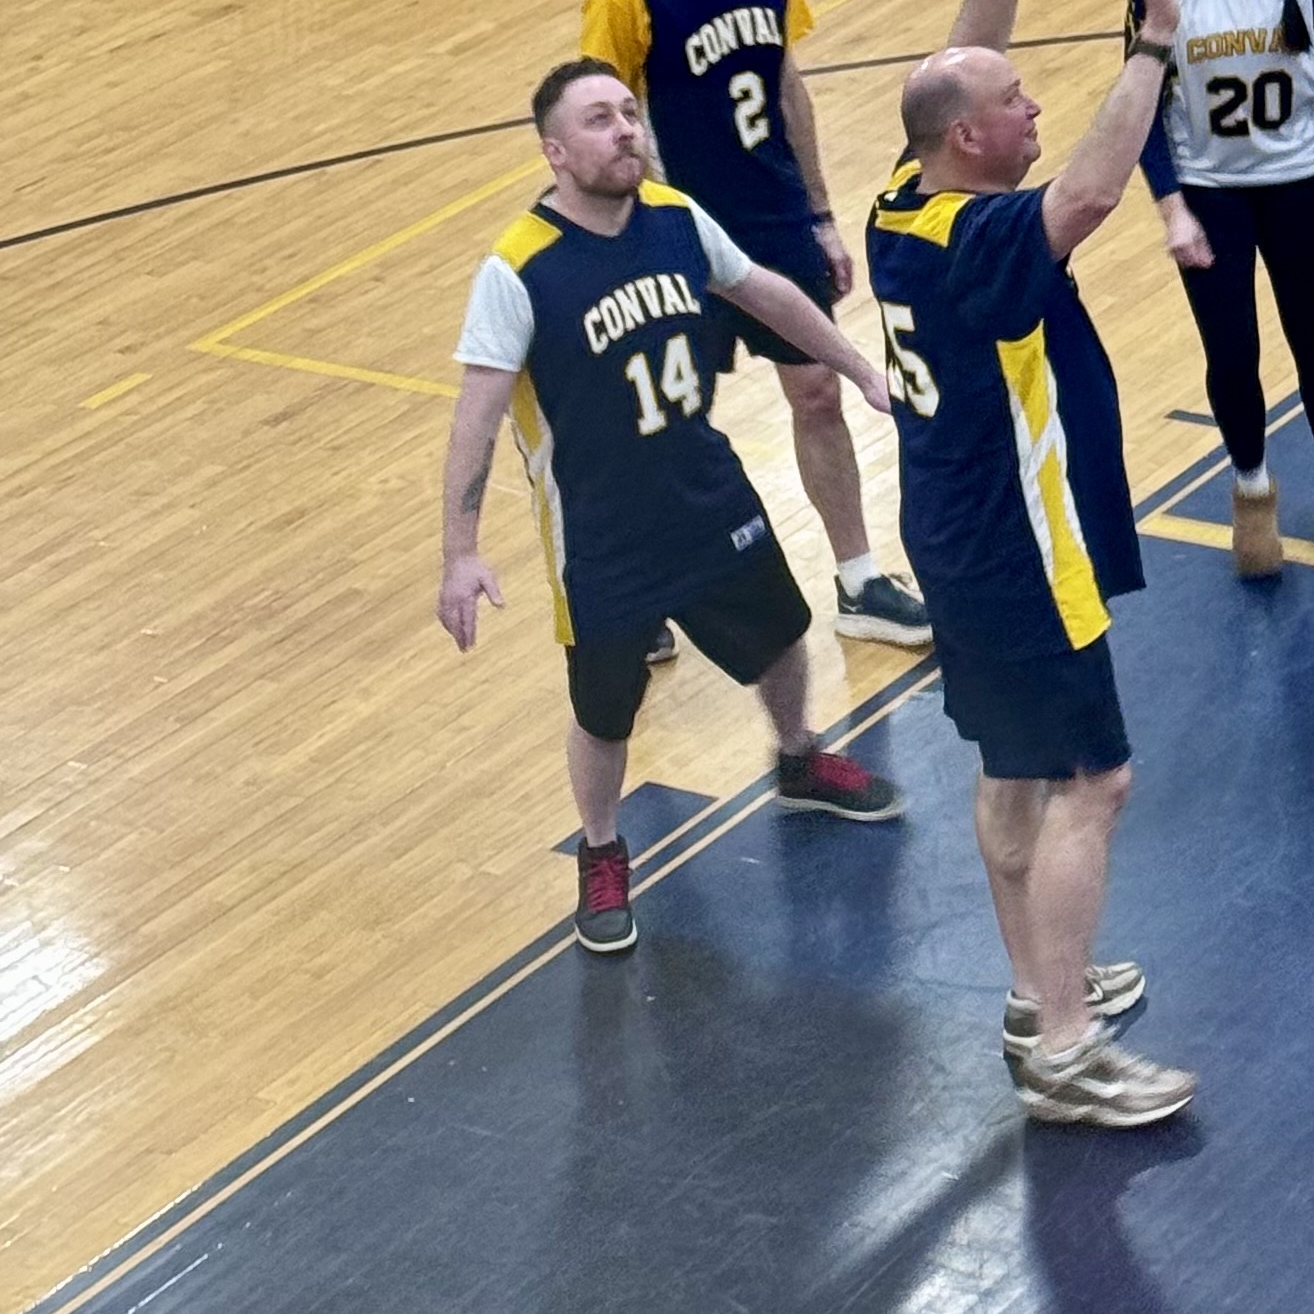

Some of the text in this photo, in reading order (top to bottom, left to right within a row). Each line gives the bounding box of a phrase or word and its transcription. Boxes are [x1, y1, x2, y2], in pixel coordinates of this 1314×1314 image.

[685, 6, 783, 76] CONVAL
[1186, 27, 1284, 65] CONVA
[728, 70, 769, 152] 2
[1206, 69, 1294, 138] 20
[583, 273, 701, 355] CONVAL
[624, 332, 702, 436] 14
